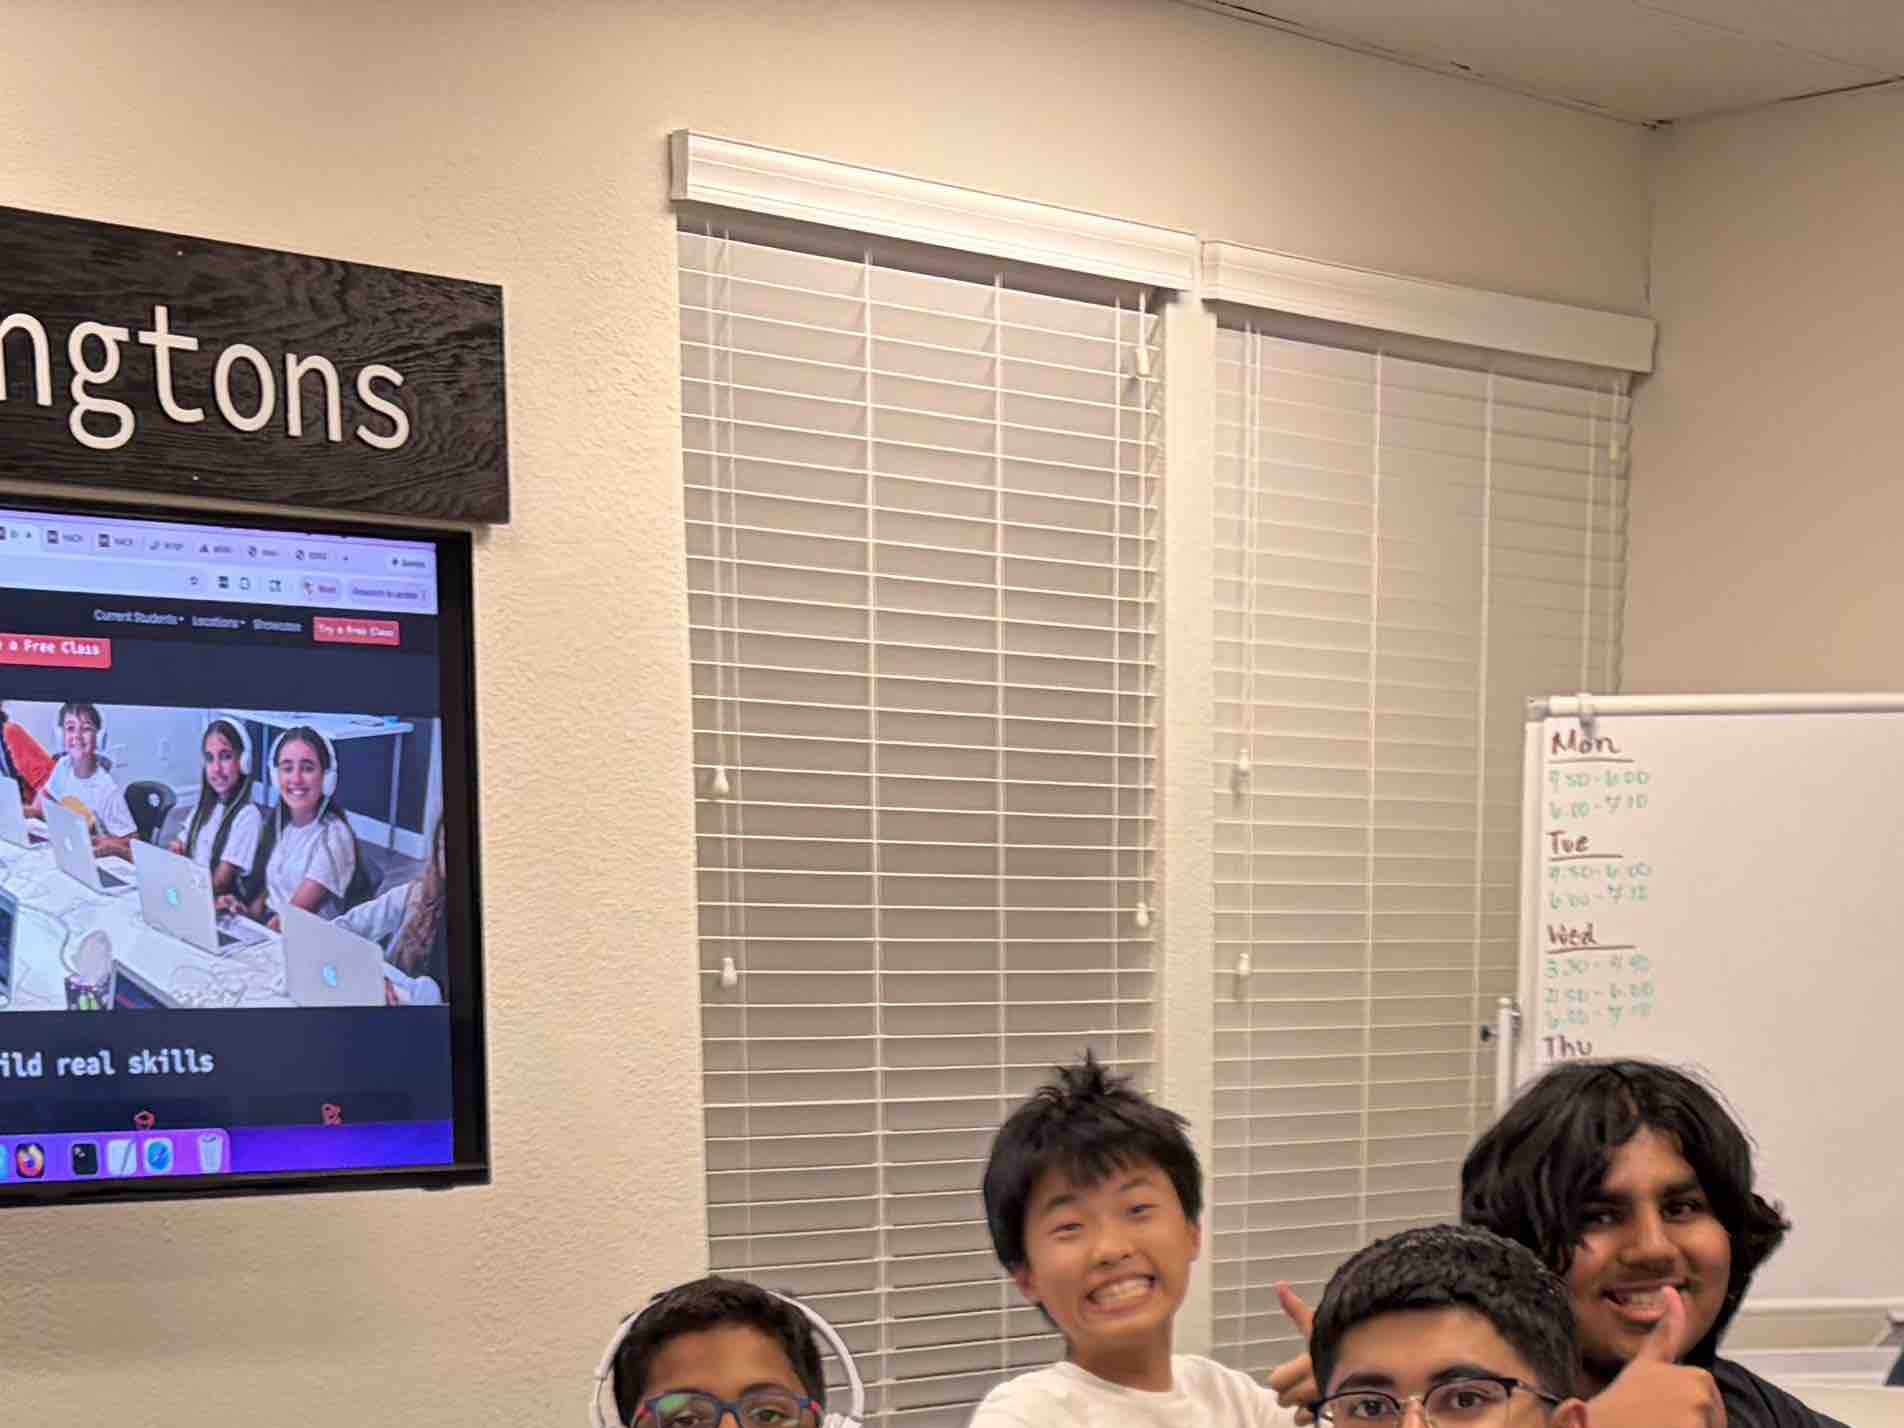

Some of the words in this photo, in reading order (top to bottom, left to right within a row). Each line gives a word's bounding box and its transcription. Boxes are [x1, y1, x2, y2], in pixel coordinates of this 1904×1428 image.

[23, 639, 57, 654] Free
[61, 640, 100, 656] Class
[1552, 729, 1621, 756] Mon
[1547, 830, 1590, 855] Tue
[1547, 922, 1599, 946] Wed
[1542, 1033, 1594, 1058] Thu
[56, 1050, 116, 1077] real
[127, 1048, 215, 1075] skills
